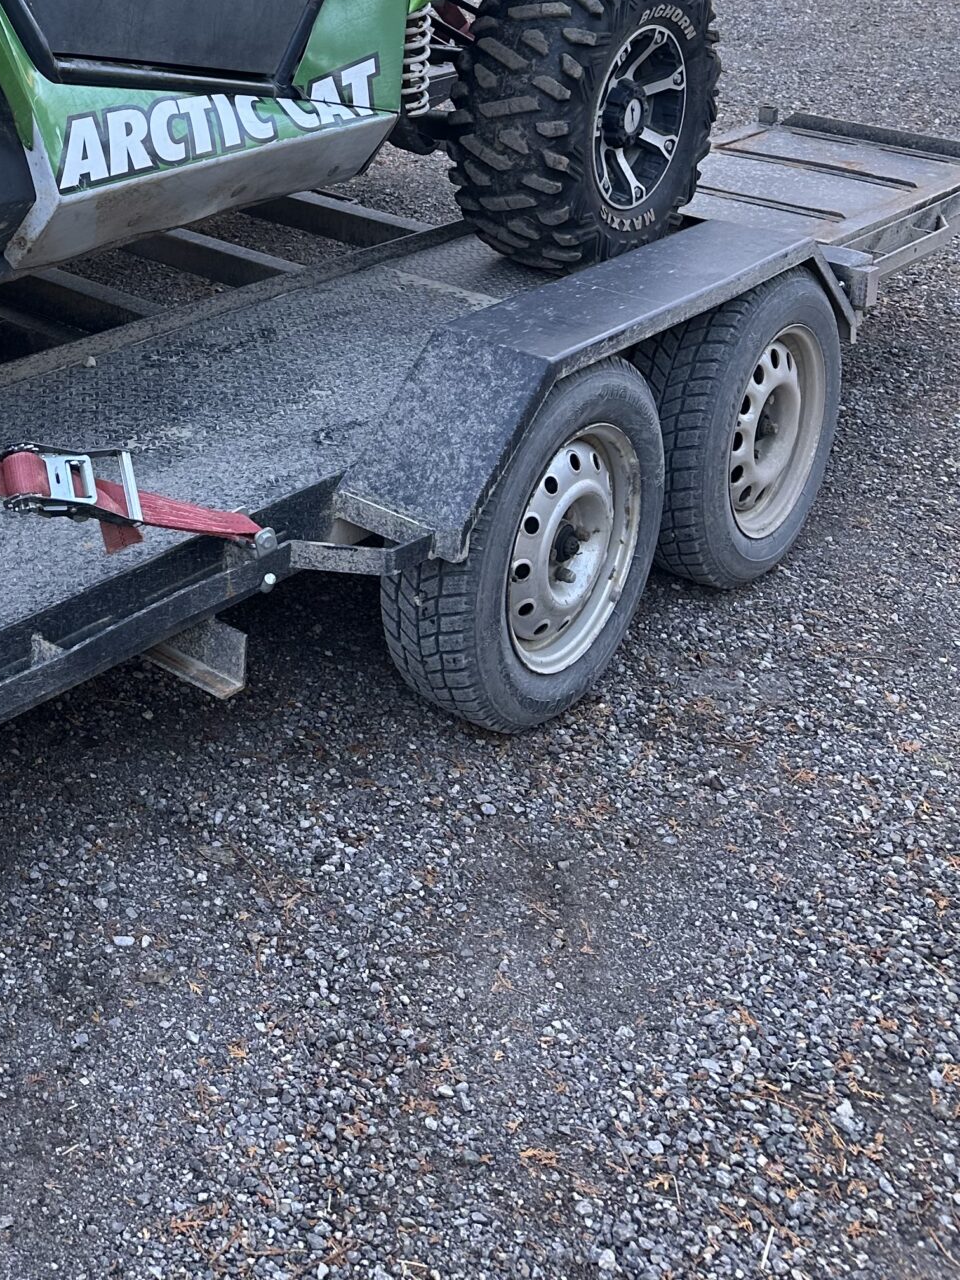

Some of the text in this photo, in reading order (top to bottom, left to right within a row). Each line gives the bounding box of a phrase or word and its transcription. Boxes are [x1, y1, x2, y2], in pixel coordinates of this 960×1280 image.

[639, 2, 697, 41] BIGHORN
[59, 57, 377, 191] ARCTIC CAT
[600, 204, 656, 232] MAXXIS
